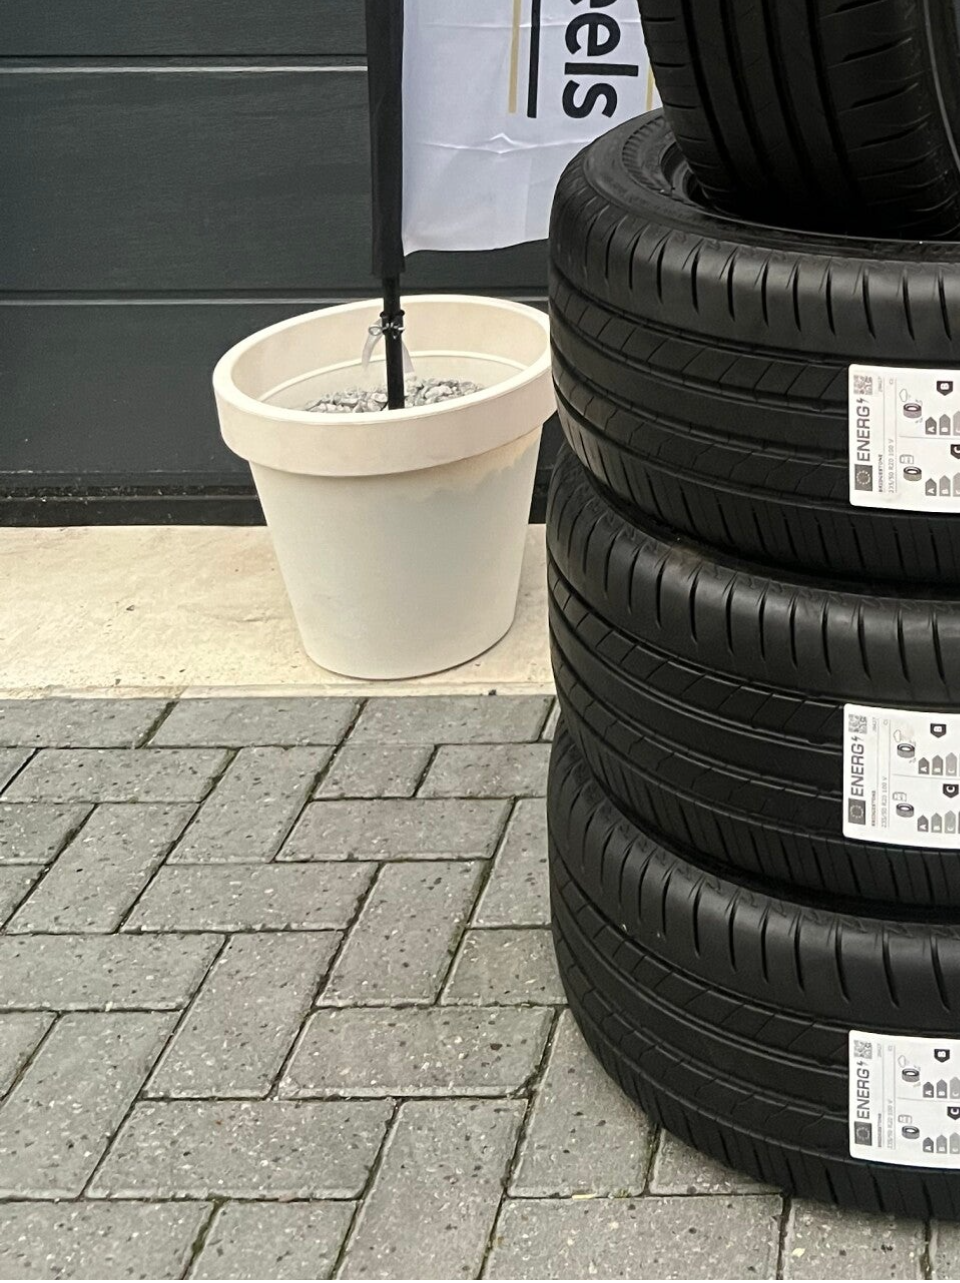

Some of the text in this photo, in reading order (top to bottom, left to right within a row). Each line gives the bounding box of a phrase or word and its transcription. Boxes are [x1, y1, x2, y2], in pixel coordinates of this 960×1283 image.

[857, 406, 870, 462] ENERG
[851, 743, 864, 797] ENERG
[857, 1068, 869, 1119] ENERG
